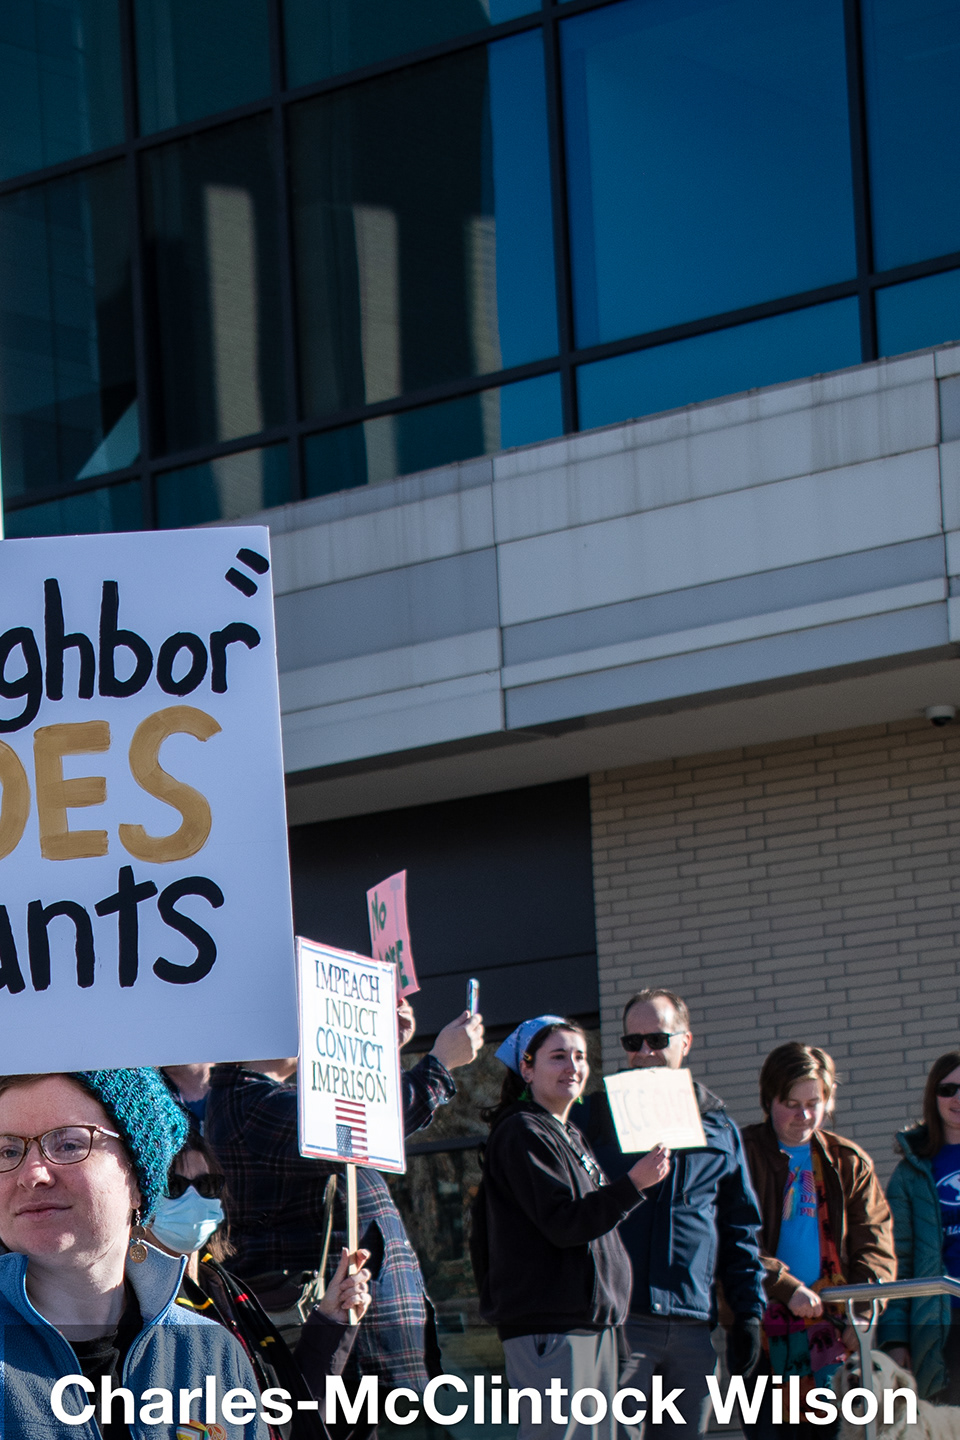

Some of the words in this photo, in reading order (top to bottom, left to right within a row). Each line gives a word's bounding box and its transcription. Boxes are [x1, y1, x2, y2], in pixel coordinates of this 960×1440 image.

[314, 960, 380, 1004] IMPEACH
[325, 998, 378, 1037] INDICT
[316, 1026, 383, 1073] CONVICT
[311, 1061, 387, 1104] IMPRISON
